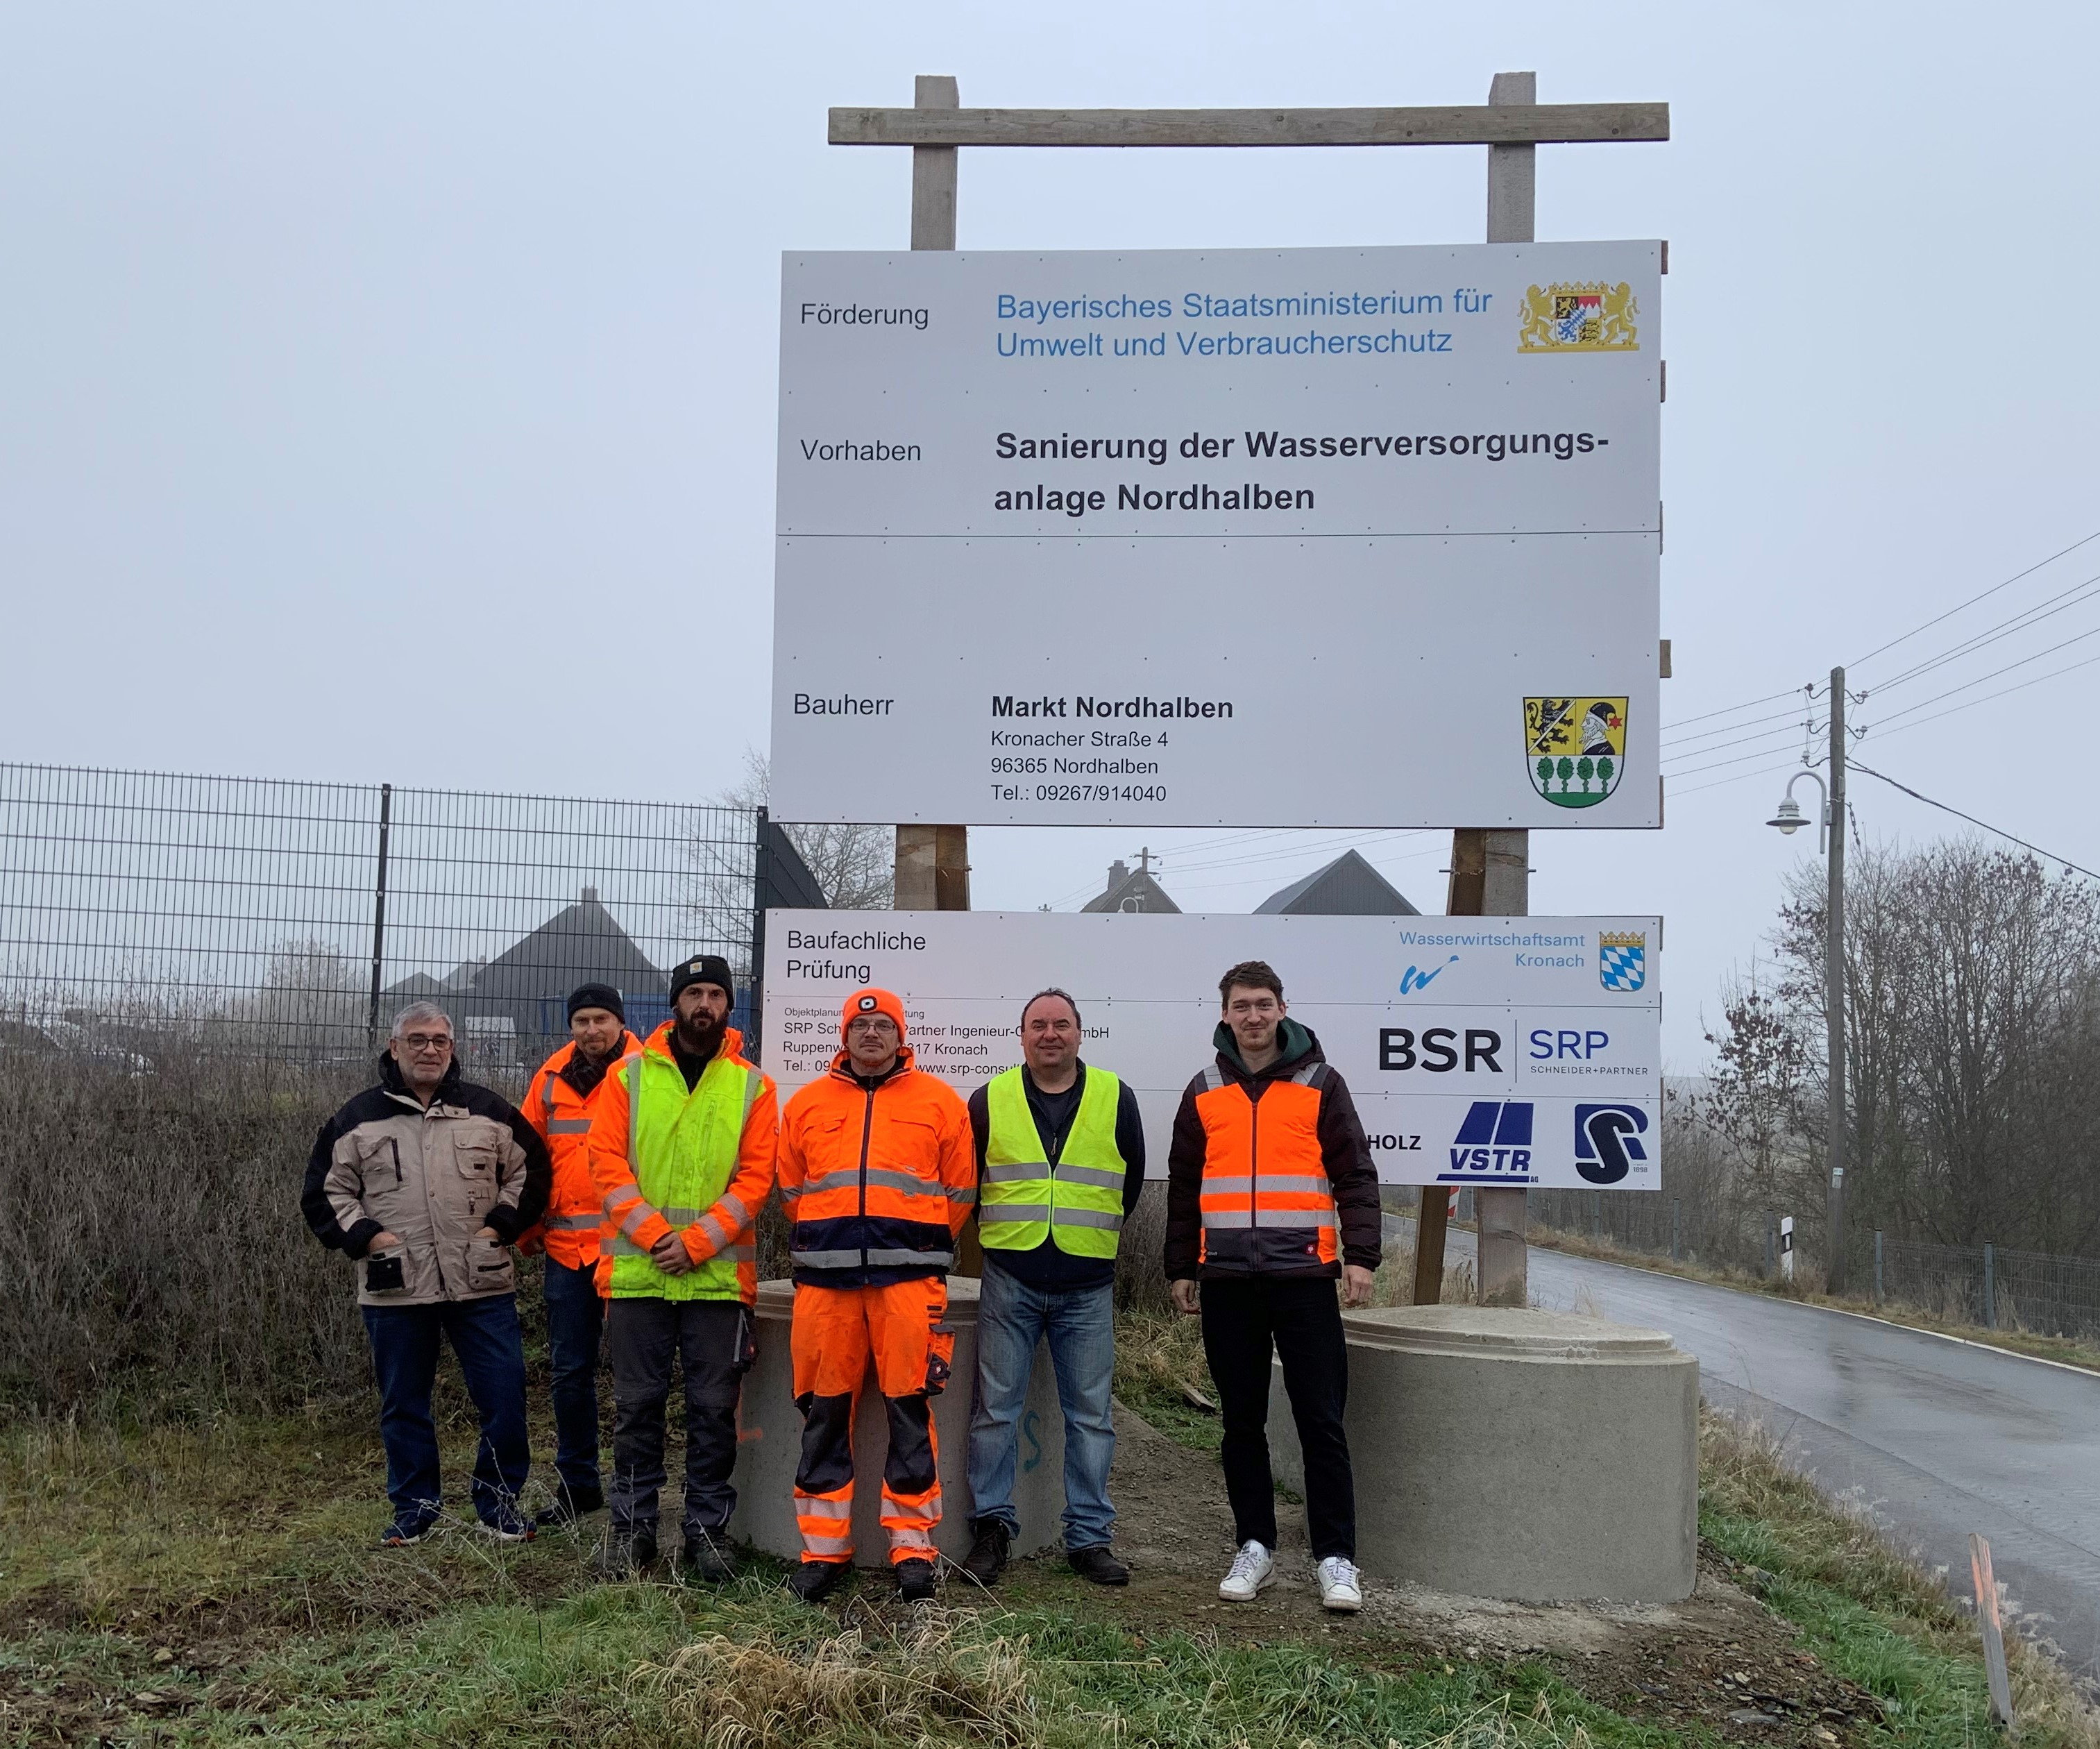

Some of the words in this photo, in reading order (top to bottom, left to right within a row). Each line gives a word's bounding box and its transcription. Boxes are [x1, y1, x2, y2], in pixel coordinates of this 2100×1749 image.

[802, 303, 929, 330] Förderung
[998, 294, 1172, 325] Bayerisches
[1183, 290, 1442, 318] Staatsministerium
[1453, 288, 1493, 313] für
[997, 332, 1103, 357] Umwelt
[1114, 332, 1165, 357] und
[1176, 328, 1453, 356] Verbraucherschutz
[800, 439, 921, 462] Vorhaben
[996, 432, 1167, 466] Sanierung
[1180, 432, 1235, 459] der
[1244, 431, 1609, 462] Wasserversorgungs-
[994, 484, 1106, 518] anlage
[1118, 483, 1314, 510] Nordhalben
[794, 693, 895, 716] Bauherr
[992, 695, 1067, 718] Markt
[1076, 696, 1233, 718] Nordhalben
[992, 730, 1085, 747] Kronacher
[1091, 731, 1151, 747] Straße
[1157, 731, 1169, 747] 4
[991, 757, 1047, 773] 96365
[1054, 758, 1158, 774] Nordhalben
[990, 784, 1029, 800] Tel.:
[1036, 785, 1167, 802] 09267/914040
[788, 930, 926, 950] Baufachliche
[1399, 931, 1586, 947] Wasserwirtschaftsamt
[787, 959, 870, 984] Prüfung
[1516, 953, 1584, 968] Kronach
[784, 1006, 845, 1018] Objektplanun
[903, 1009, 924, 1020] tung
[784, 1022, 813, 1033] SRP
[817, 1022, 841, 1034] Sch
[905, 1024, 947, 1036] artner
[951, 1024, 1022, 1040] Ingenieur-C
[1081, 1026, 1109, 1038] mbH
[783, 1041, 844, 1056] Ruppenw
[935, 1043, 988, 1056] Kronach
[1379, 1027, 1504, 1073] BSR
[1529, 1029, 1609, 1060] SRP
[783, 1060, 811, 1071] Tel.:
[815, 1060, 831, 1072] 09
[1530, 1065, 1649, 1076] SCHNEIDER+PARTNER
[1450, 1148, 1531, 1172] VSTR
